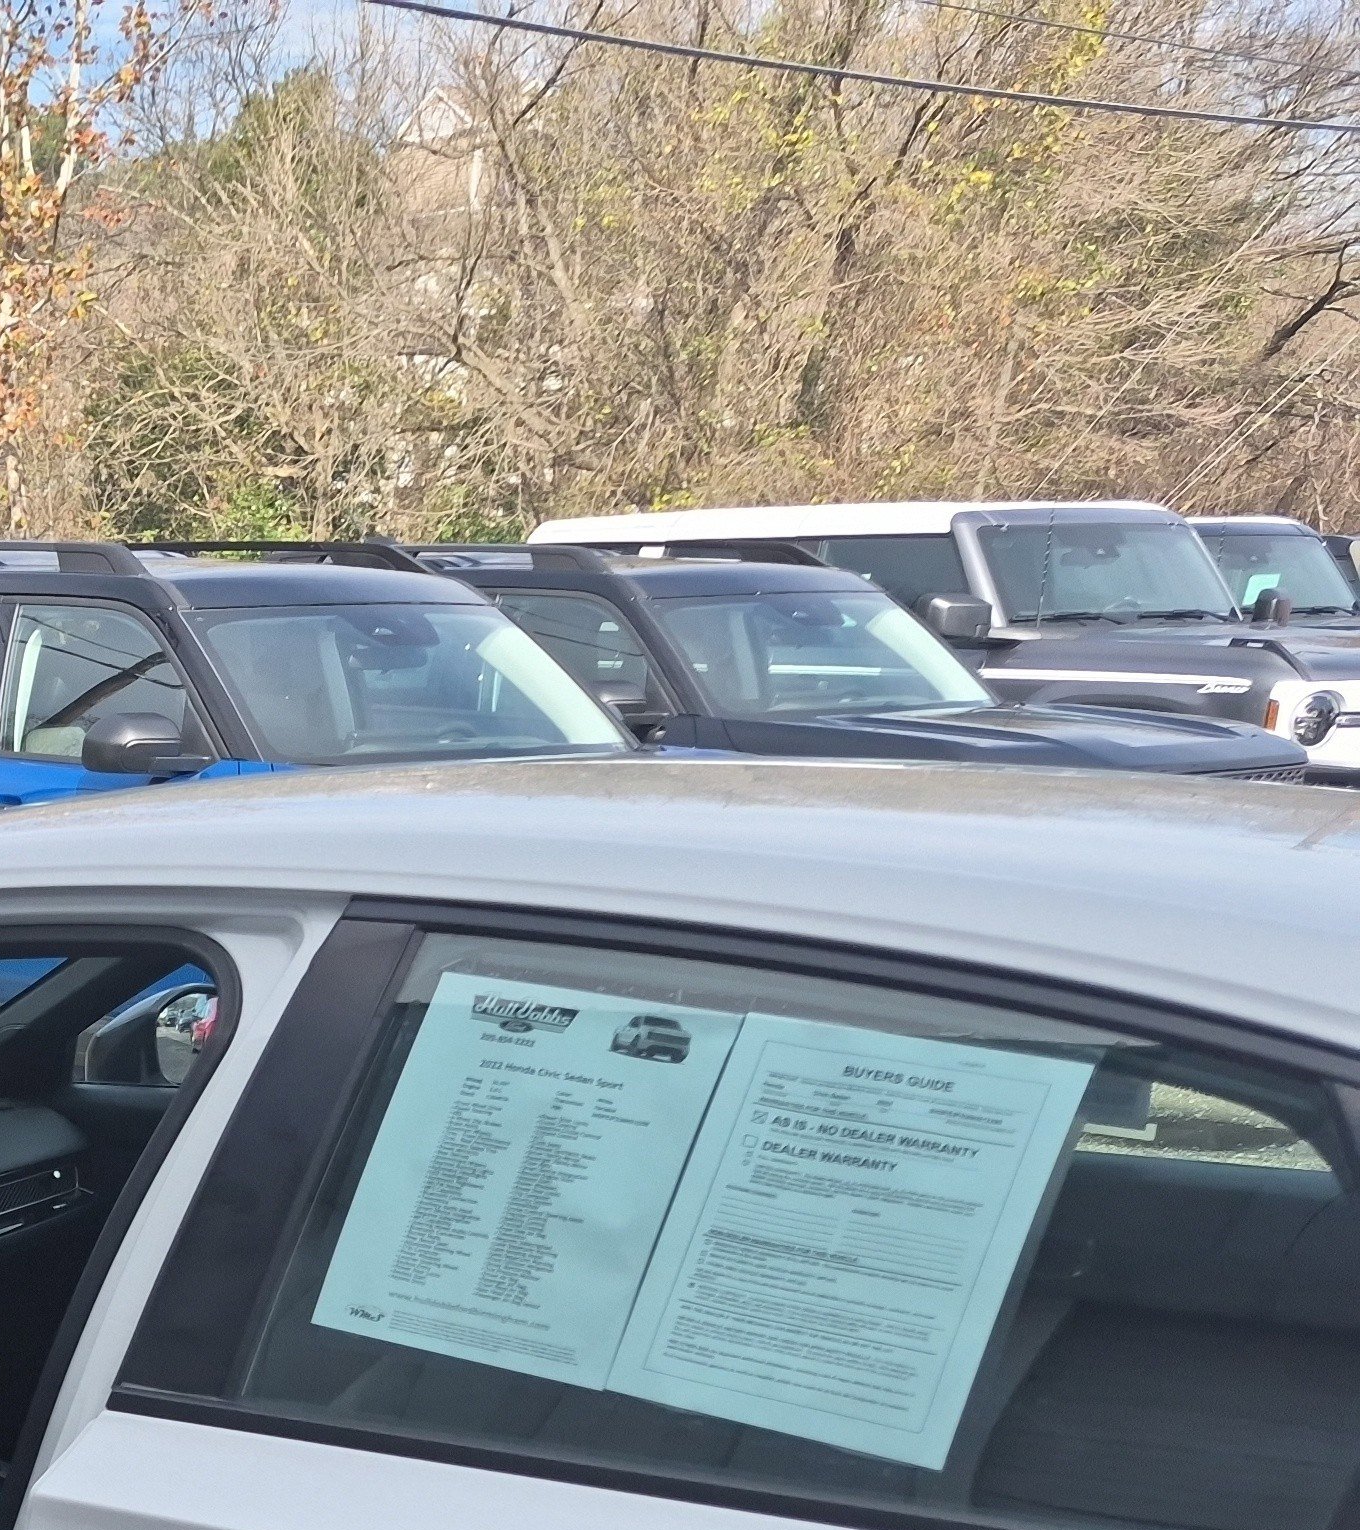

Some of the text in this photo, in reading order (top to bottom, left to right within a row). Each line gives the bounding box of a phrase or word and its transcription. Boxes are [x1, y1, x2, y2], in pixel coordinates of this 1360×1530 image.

[505, 1062, 537, 1076] Honda
[537, 1068, 561, 1080] Civic
[563, 1072, 594, 1085] Sedan
[595, 1077, 624, 1091] Sport
[843, 1065, 903, 1084] BUYERS
[907, 1075, 956, 1093] GUIDE
[770, 1115, 791, 1129] AS
[793, 1118, 808, 1131] IS
[817, 1122, 840, 1136] NO
[840, 1126, 897, 1145] DEALER
[897, 1134, 981, 1159] WARRANTY
[761, 1140, 818, 1161] DEALER
[819, 1150, 899, 1173] WARRANTY
